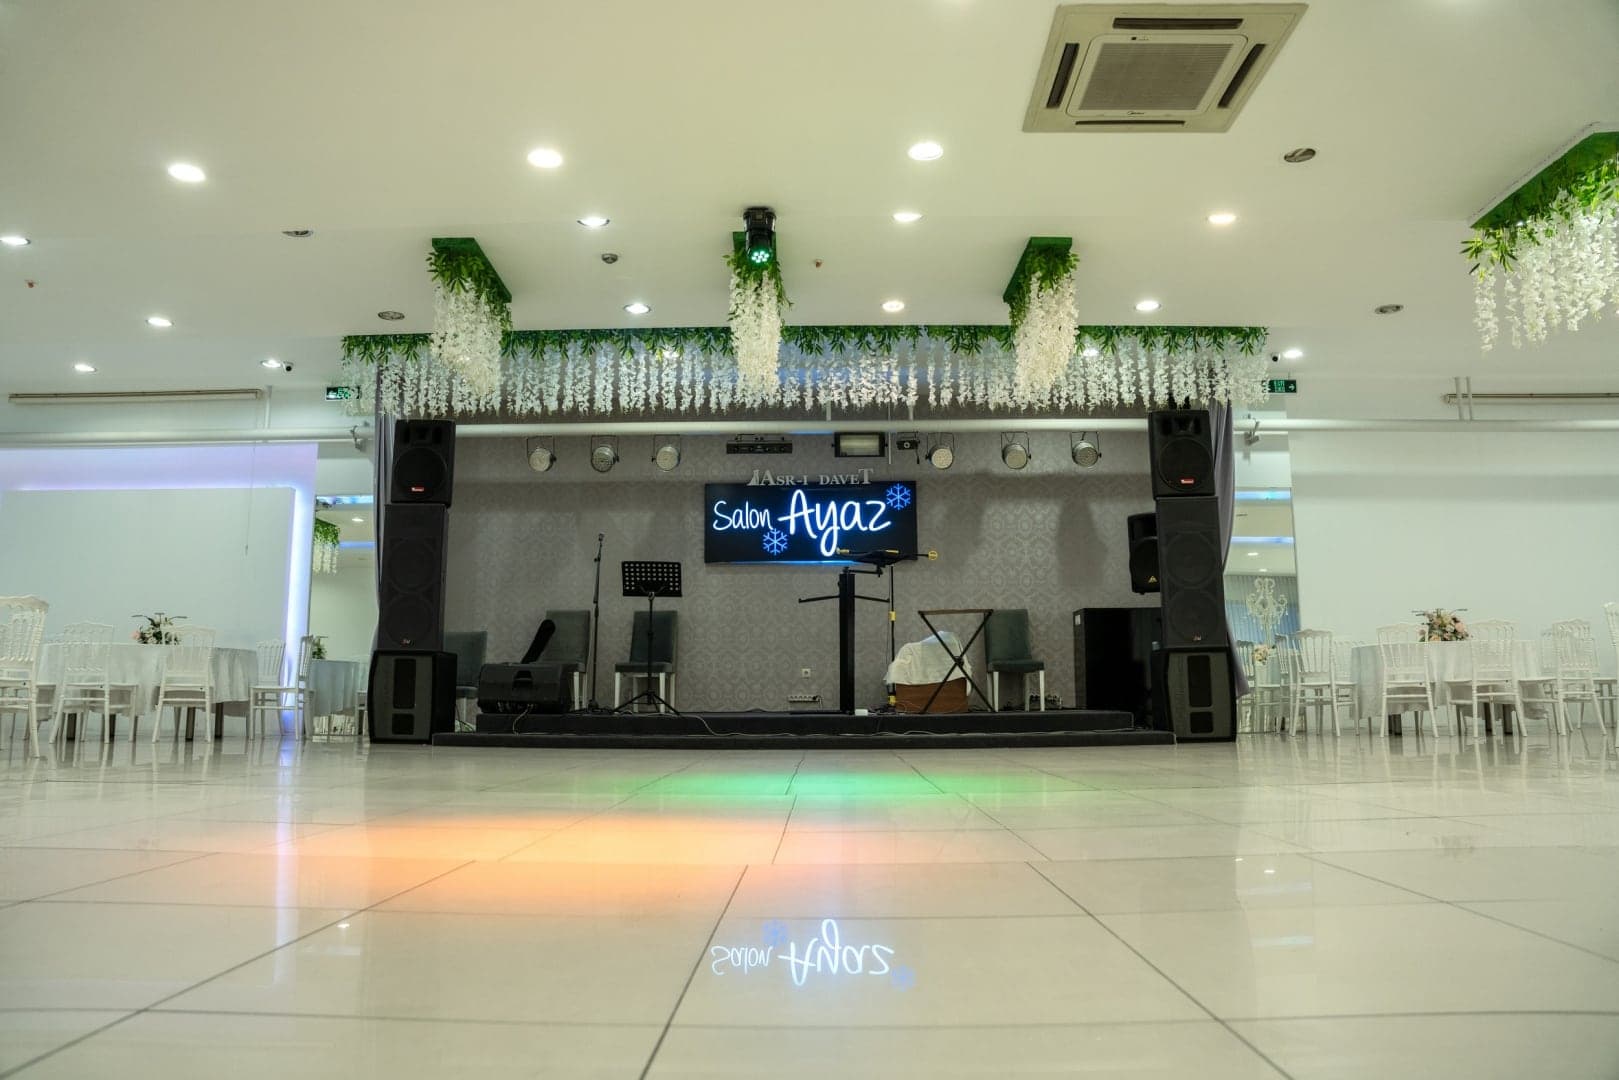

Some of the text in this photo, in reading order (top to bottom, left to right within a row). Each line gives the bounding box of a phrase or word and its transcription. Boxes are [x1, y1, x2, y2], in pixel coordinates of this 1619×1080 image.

[818, 468, 874, 485] DAVET
[713, 489, 892, 557] Salon Ayaz
